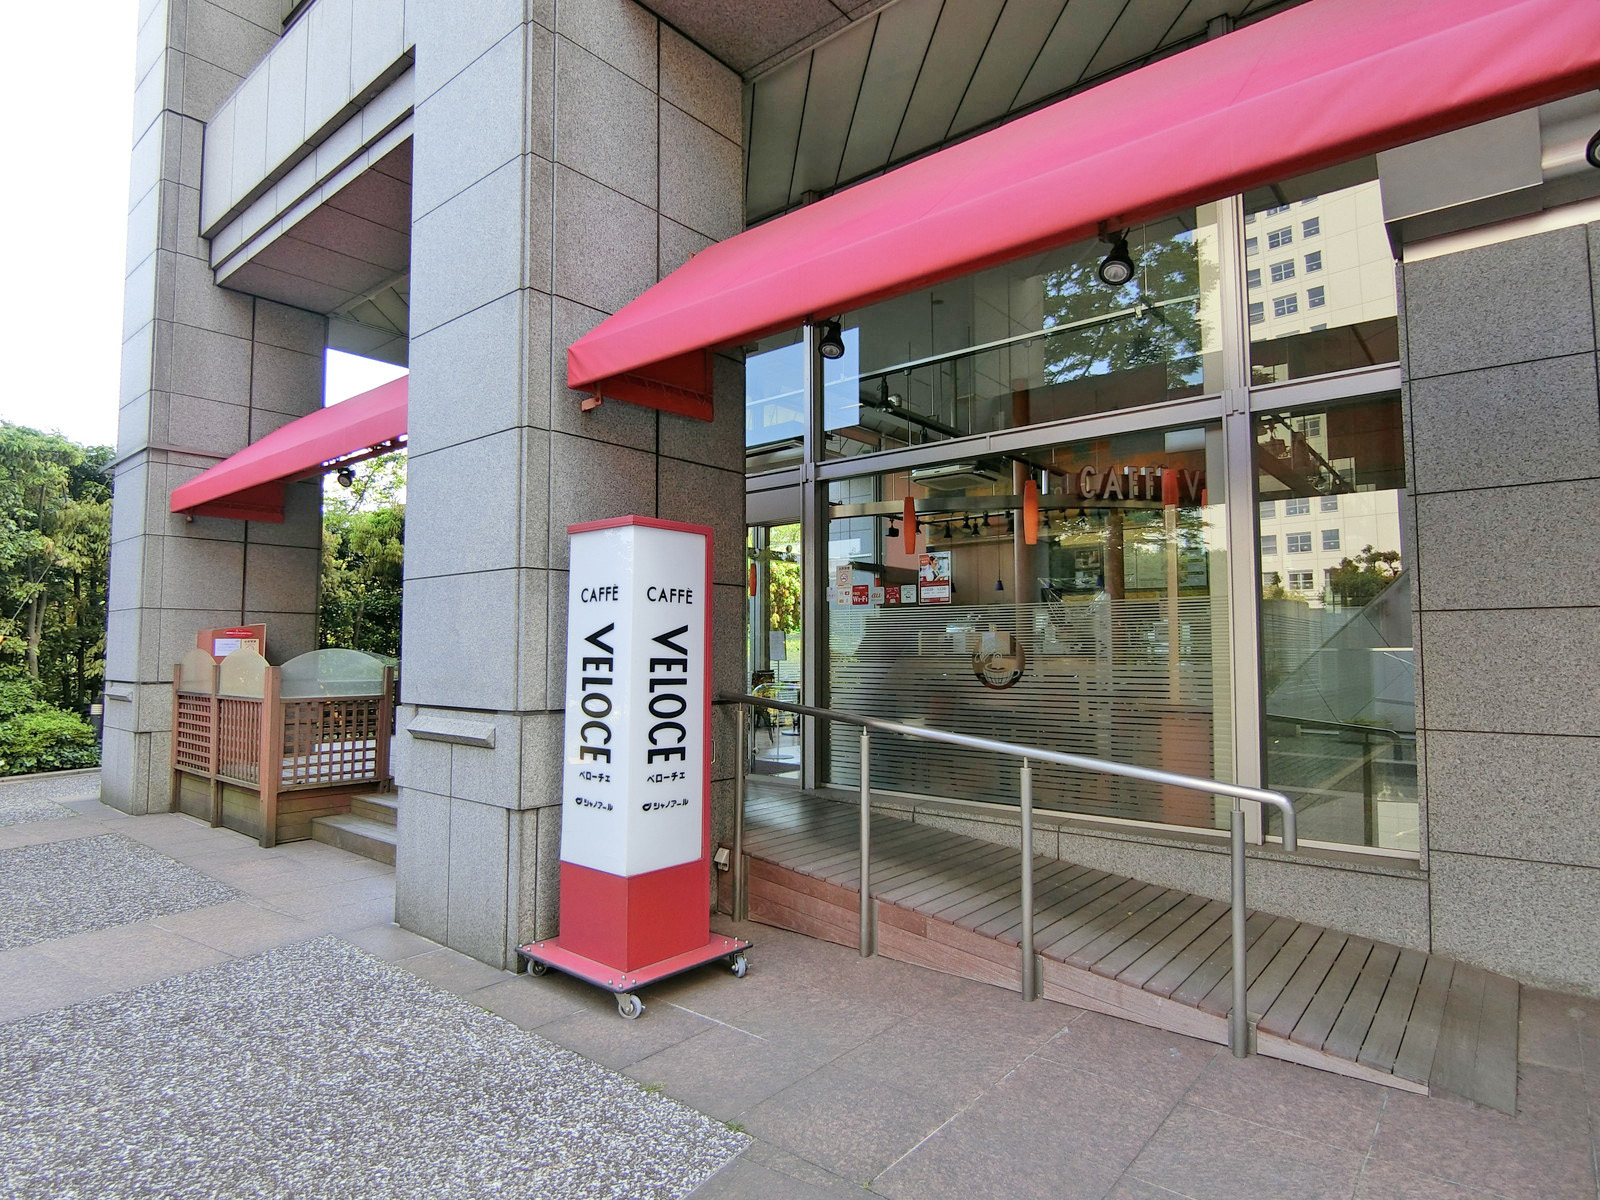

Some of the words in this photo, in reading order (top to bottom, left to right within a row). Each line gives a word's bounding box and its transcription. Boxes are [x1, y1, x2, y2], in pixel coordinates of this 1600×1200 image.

[1079, 464, 1179, 500] CAFF
[581, 584, 619, 603] CAFFÈ
[647, 586, 693, 605] CAFFÈ
[579, 622, 615, 764] VELOCE
[647, 624, 689, 765] VELOCE
